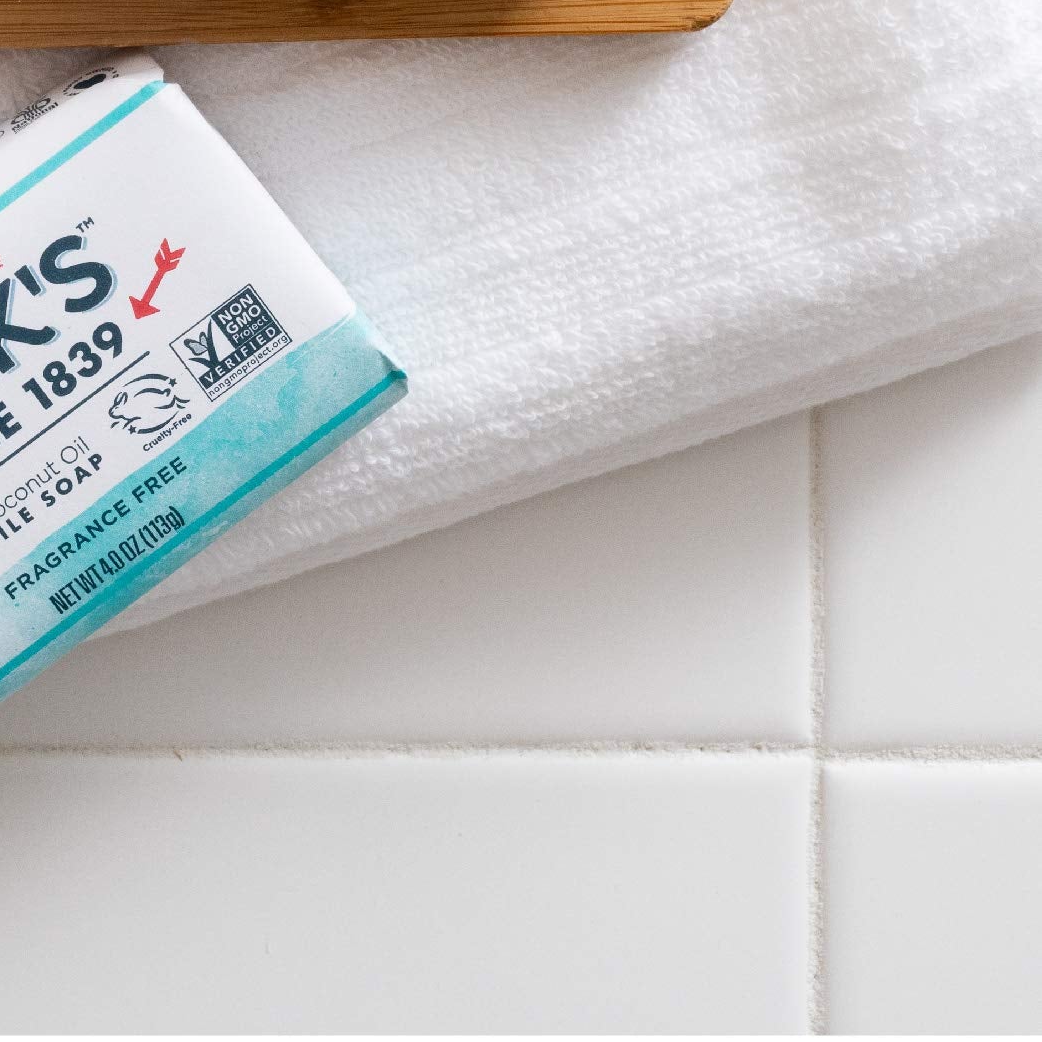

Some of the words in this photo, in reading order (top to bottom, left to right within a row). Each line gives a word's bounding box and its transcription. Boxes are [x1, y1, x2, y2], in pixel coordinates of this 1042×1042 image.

[217, 294, 254, 325] NON
[225, 304, 261, 334] GMO
[232, 315, 269, 344] Project
[22, 322, 123, 410] 1839
[205, 327, 276, 383] VERIFIED
[208, 334, 289, 397] nongmoproject.org
[60, 435, 90, 465] Oil
[142, 413, 192, 452] Cruelty-Free
[40, 452, 103, 507] SOAP
[4, 499, 131, 600] FRAGRANCE
[131, 455, 187, 504] FREE
[49, 581, 81, 614] NET
[74, 563, 105, 595] WT
[98, 550, 126, 576] 4.0
[118, 534, 146, 562] OZ
[138, 505, 186, 549] (113g)
